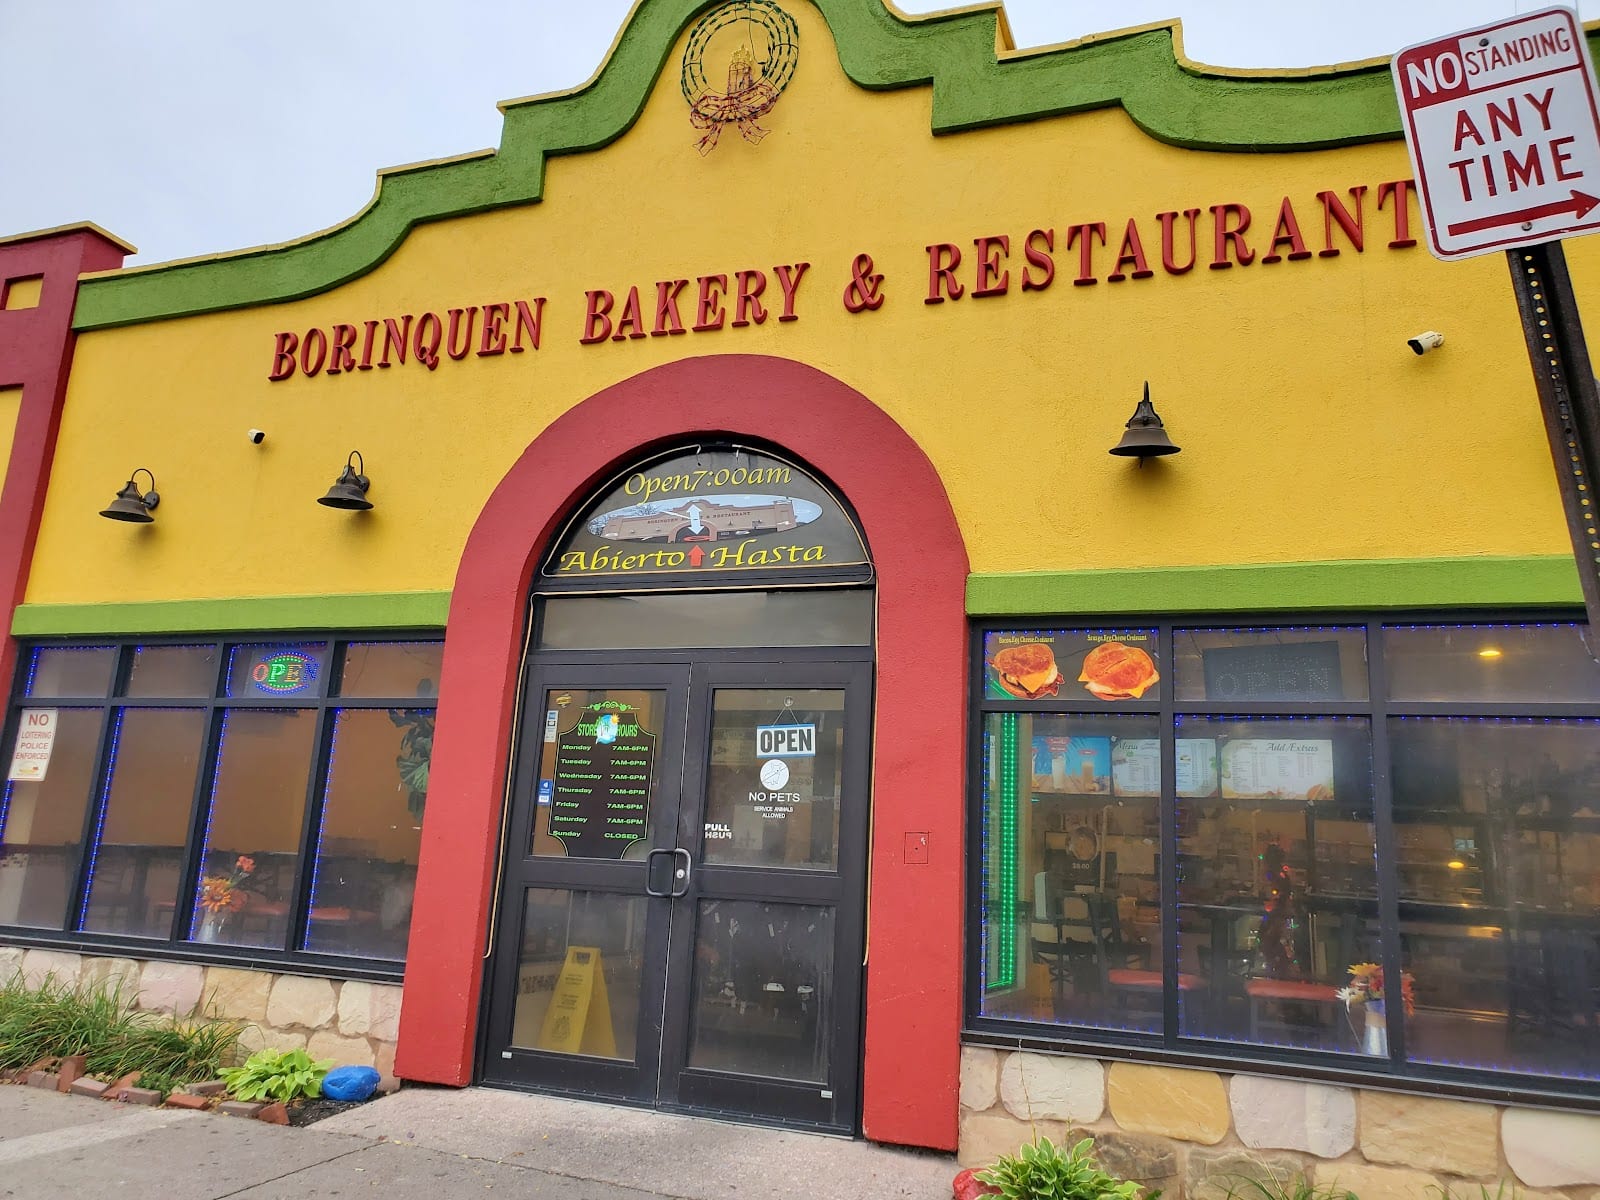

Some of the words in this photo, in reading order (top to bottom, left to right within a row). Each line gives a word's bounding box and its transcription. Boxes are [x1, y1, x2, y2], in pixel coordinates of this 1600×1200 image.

[1406, 51, 1464, 99] NO
[1464, 27, 1572, 76] STANDING
[1453, 86, 1555, 152] ANY
[1448, 135, 1585, 202] TIME
[267, 296, 548, 381] BORINQUEN
[579, 261, 811, 344] BAKERY
[843, 252, 886, 313] &
[923, 178, 1417, 306] RESTAURANT
[560, 545, 686, 571] Abierto
[709, 539, 827, 568] Hasta
[252, 662, 320, 682] OPEN
[1215, 667, 1331, 699] OPEN
[28, 713, 49, 726] NO
[22, 731, 52, 739] LOITERING
[617, 724, 639, 737] HOURS
[21, 742, 49, 750] POLICE
[760, 728, 812, 754] OPEN
[16, 752, 49, 760] ENFORCED
[560, 758, 592, 766] Tuesday
[557, 787, 593, 795] Thursday
[748, 792, 767, 802] NO
[769, 792, 801, 803] PETS
[556, 801, 580, 809] Friday
[607, 817, 644, 825] 7AM-6PM
[704, 823, 730, 831] PULL
[552, 830, 582, 838] Sunday
[604, 832, 639, 840] CLOSED
